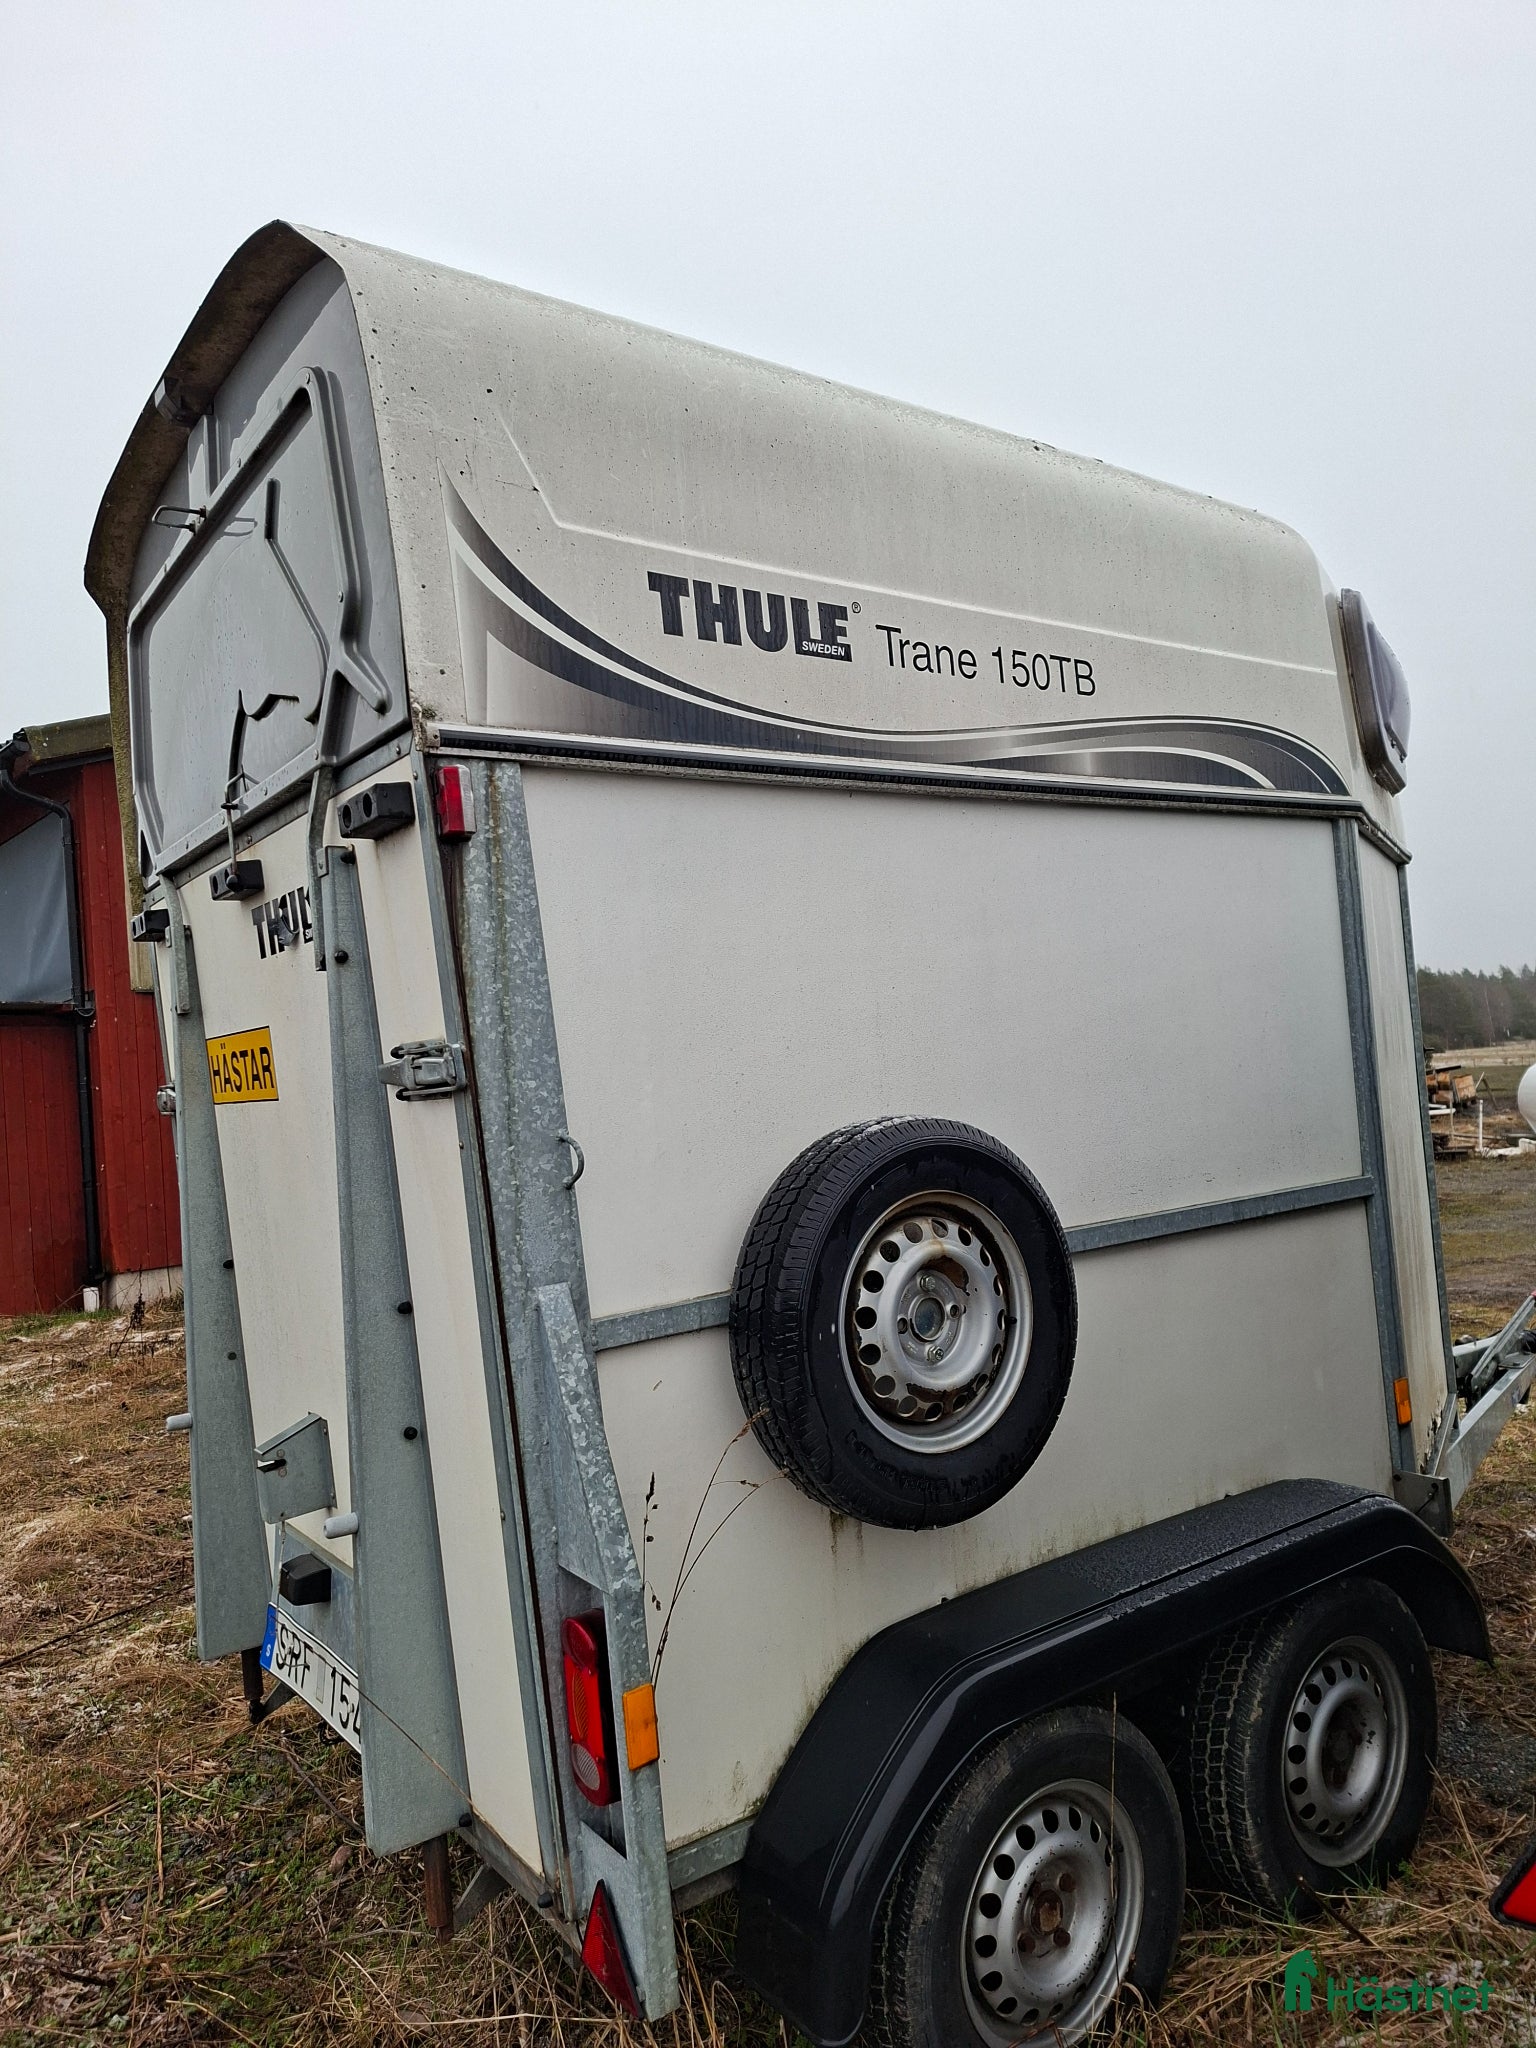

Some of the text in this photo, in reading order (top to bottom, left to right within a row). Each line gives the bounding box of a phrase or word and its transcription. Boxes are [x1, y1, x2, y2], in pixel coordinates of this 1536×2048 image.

[646, 570, 1097, 697] THULE Trane 150TB
[801, 640, 846, 657] SWEDEN
[251, 886, 314, 960] THUL
[209, 1042, 275, 1094] HÄSTAR
[275, 1624, 314, 1690] SRF
